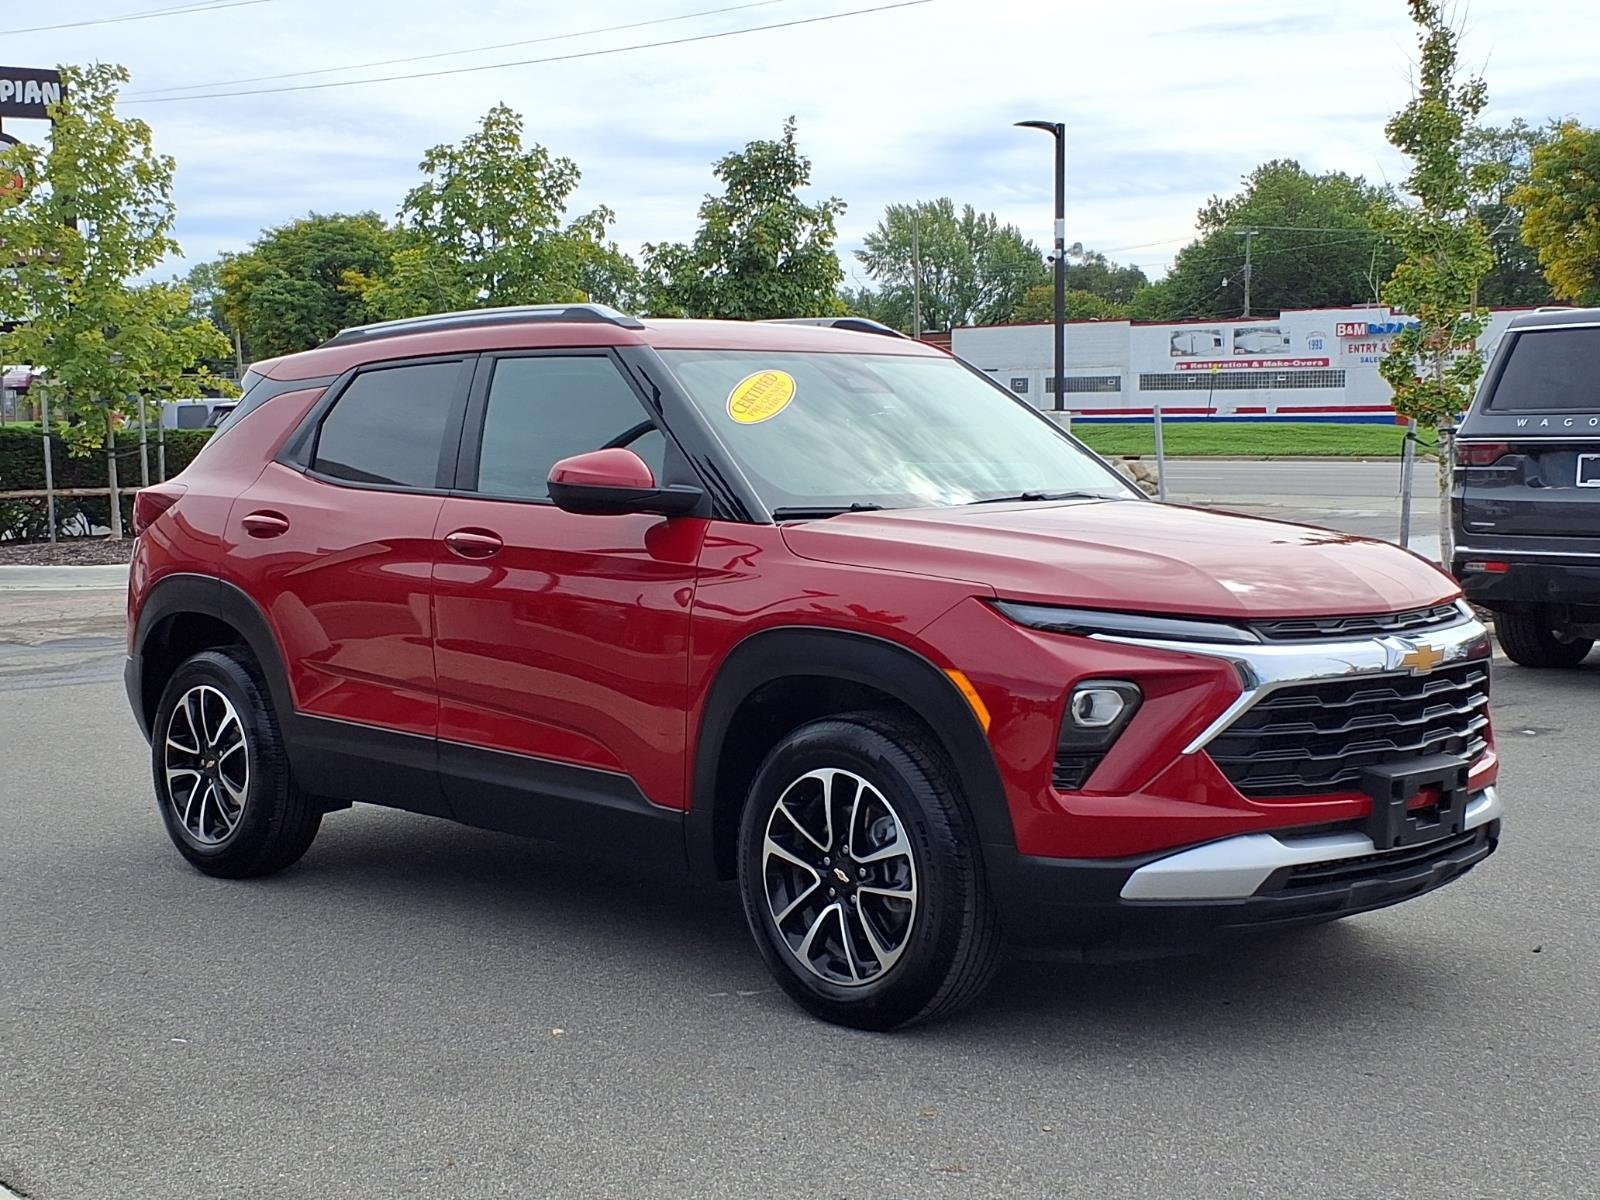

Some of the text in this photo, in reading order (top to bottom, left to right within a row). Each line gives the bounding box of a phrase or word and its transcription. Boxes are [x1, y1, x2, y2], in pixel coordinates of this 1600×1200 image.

[0, 79, 60, 106] PIAN
[1337, 323, 1367, 336] B&M
[1348, 343, 1377, 354] ENTRY
[1251, 360, 1260, 368] &
[732, 373, 778, 414] CERTIFIED
